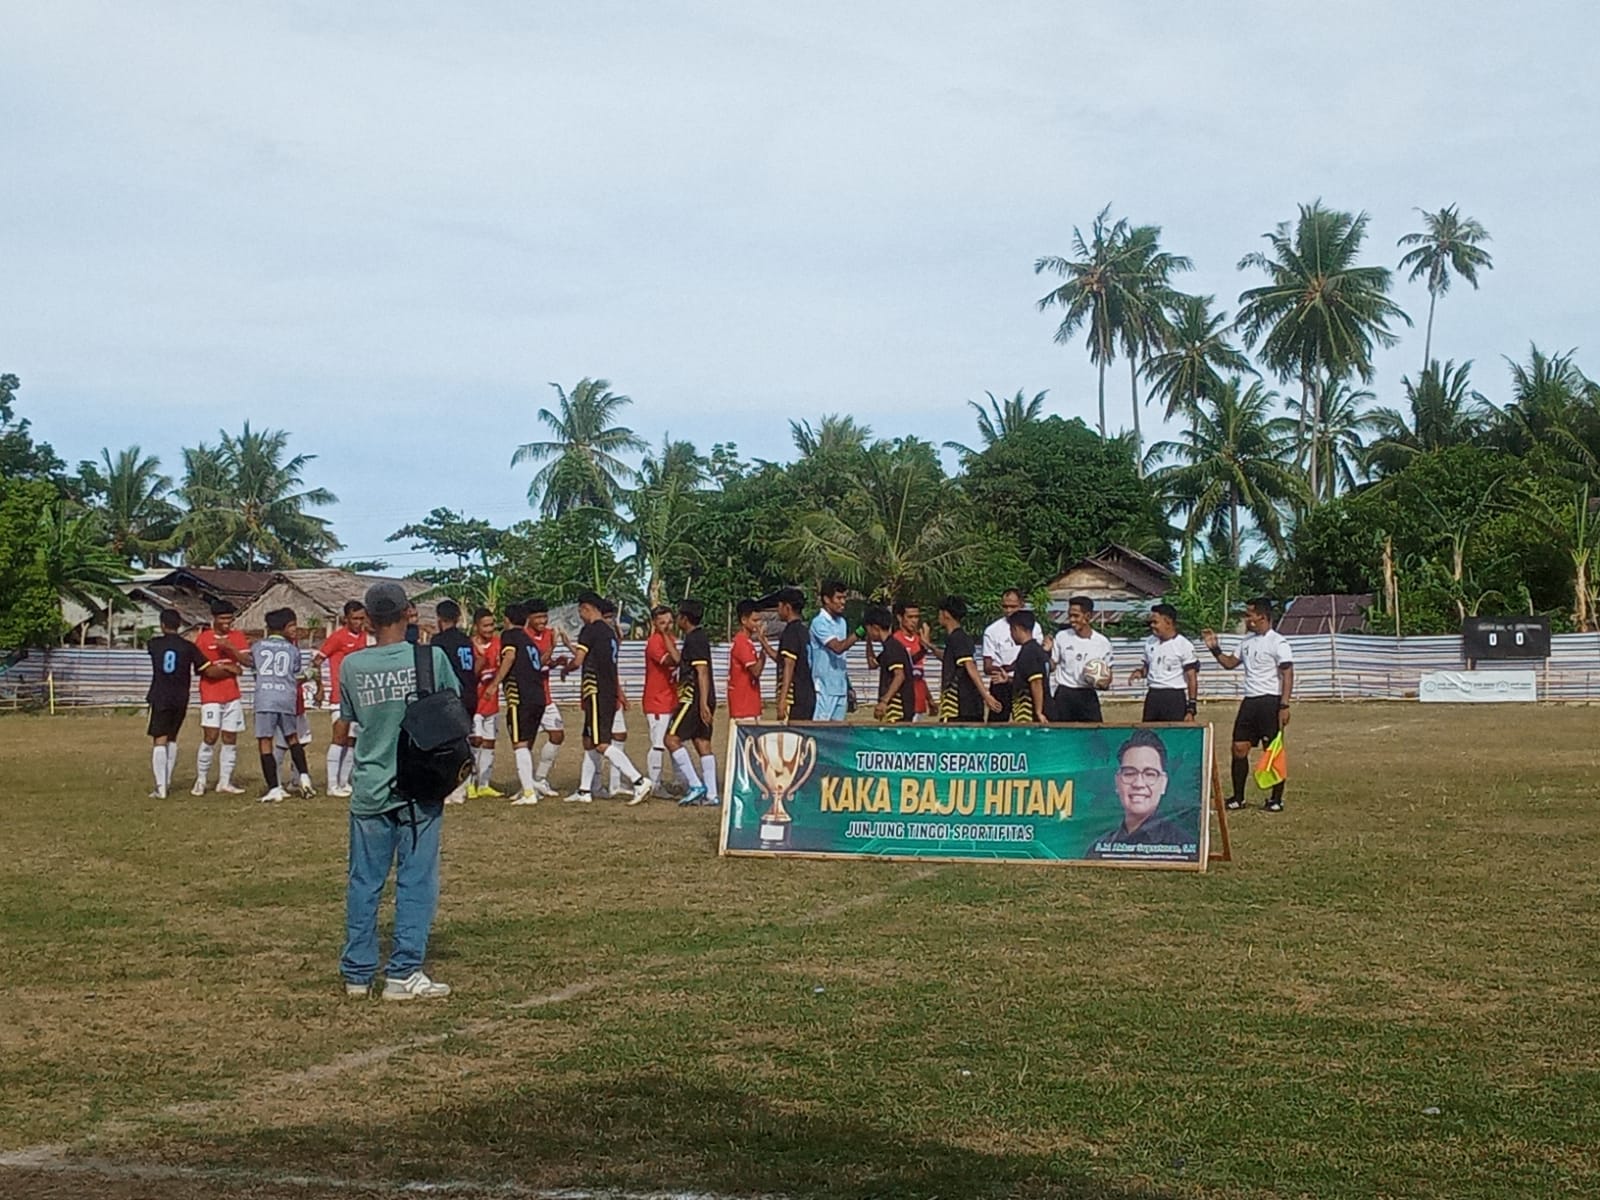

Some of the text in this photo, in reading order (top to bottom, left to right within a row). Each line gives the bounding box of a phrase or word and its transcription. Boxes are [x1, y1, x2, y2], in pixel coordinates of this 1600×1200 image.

[1489, 632, 1524, 647] 0 0
[163, 650, 177, 674] 8
[260, 649, 290, 677] 20
[457, 647, 473, 670] 15
[355, 667, 416, 690] SAVAGE
[856, 752, 1028, 774] TURNAMEN SEPAK BOLA
[820, 776, 1074, 818] KAKA BAJU HITAM
[845, 822, 1034, 842] JUNJUNG TINGGI SPORTIFITAS
